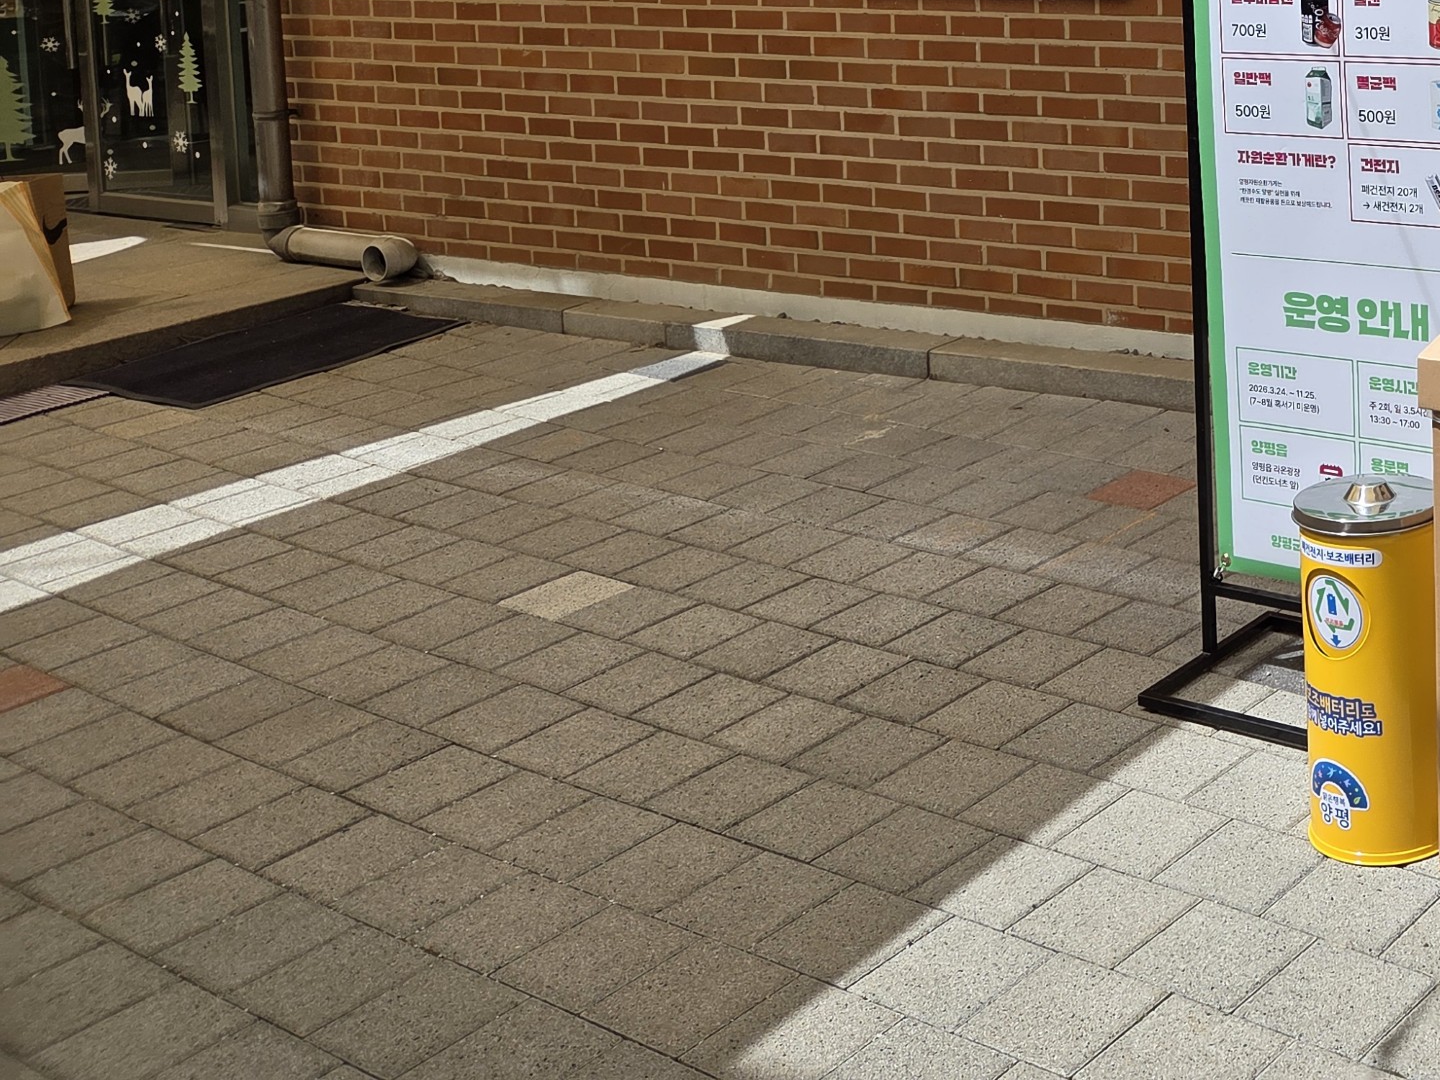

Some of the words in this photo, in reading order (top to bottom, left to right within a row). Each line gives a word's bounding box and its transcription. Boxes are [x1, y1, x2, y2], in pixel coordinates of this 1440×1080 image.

[1231, 23, 1267, 38] 700원
[1355, 25, 1391, 42] 310원
[1233, 71, 1272, 87] 일반팩
[1356, 75, 1397, 91] 멸균팩
[1235, 104, 1271, 119] 500원
[1358, 110, 1397, 125] 500원
[1237, 150, 1336, 169] 자원순환가게란?
[1360, 158, 1400, 174] 건전지
[1361, 184, 1395, 197] 폐건전지
[1397, 186, 1418, 198] 20개
[1373, 201, 1407, 213] 새건전지
[1409, 203, 1424, 214] 2개
[1282, 291, 1350, 333] 운영
[1357, 298, 1429, 342] 안내
[1248, 361, 1297, 380] 운영기간
[1249, 384, 1288, 396] 2026.3.24.
[1296, 390, 1317, 400] 11.25.
[1249, 397, 1273, 407] (7~8월
[1274, 398, 1295, 410] 혹서기
[1296, 402, 1320, 414] 미운영)
[1369, 401, 1377, 410] 주
[1379, 402, 1392, 413] 2회,
[1370, 414, 1391, 425] 13:30
[1400, 419, 1420, 429] 17:00
[1251, 440, 1288, 457] 양평읍
[1252, 461, 1272, 472] 양평읍
[1320, 802, 1349, 828] 양평
